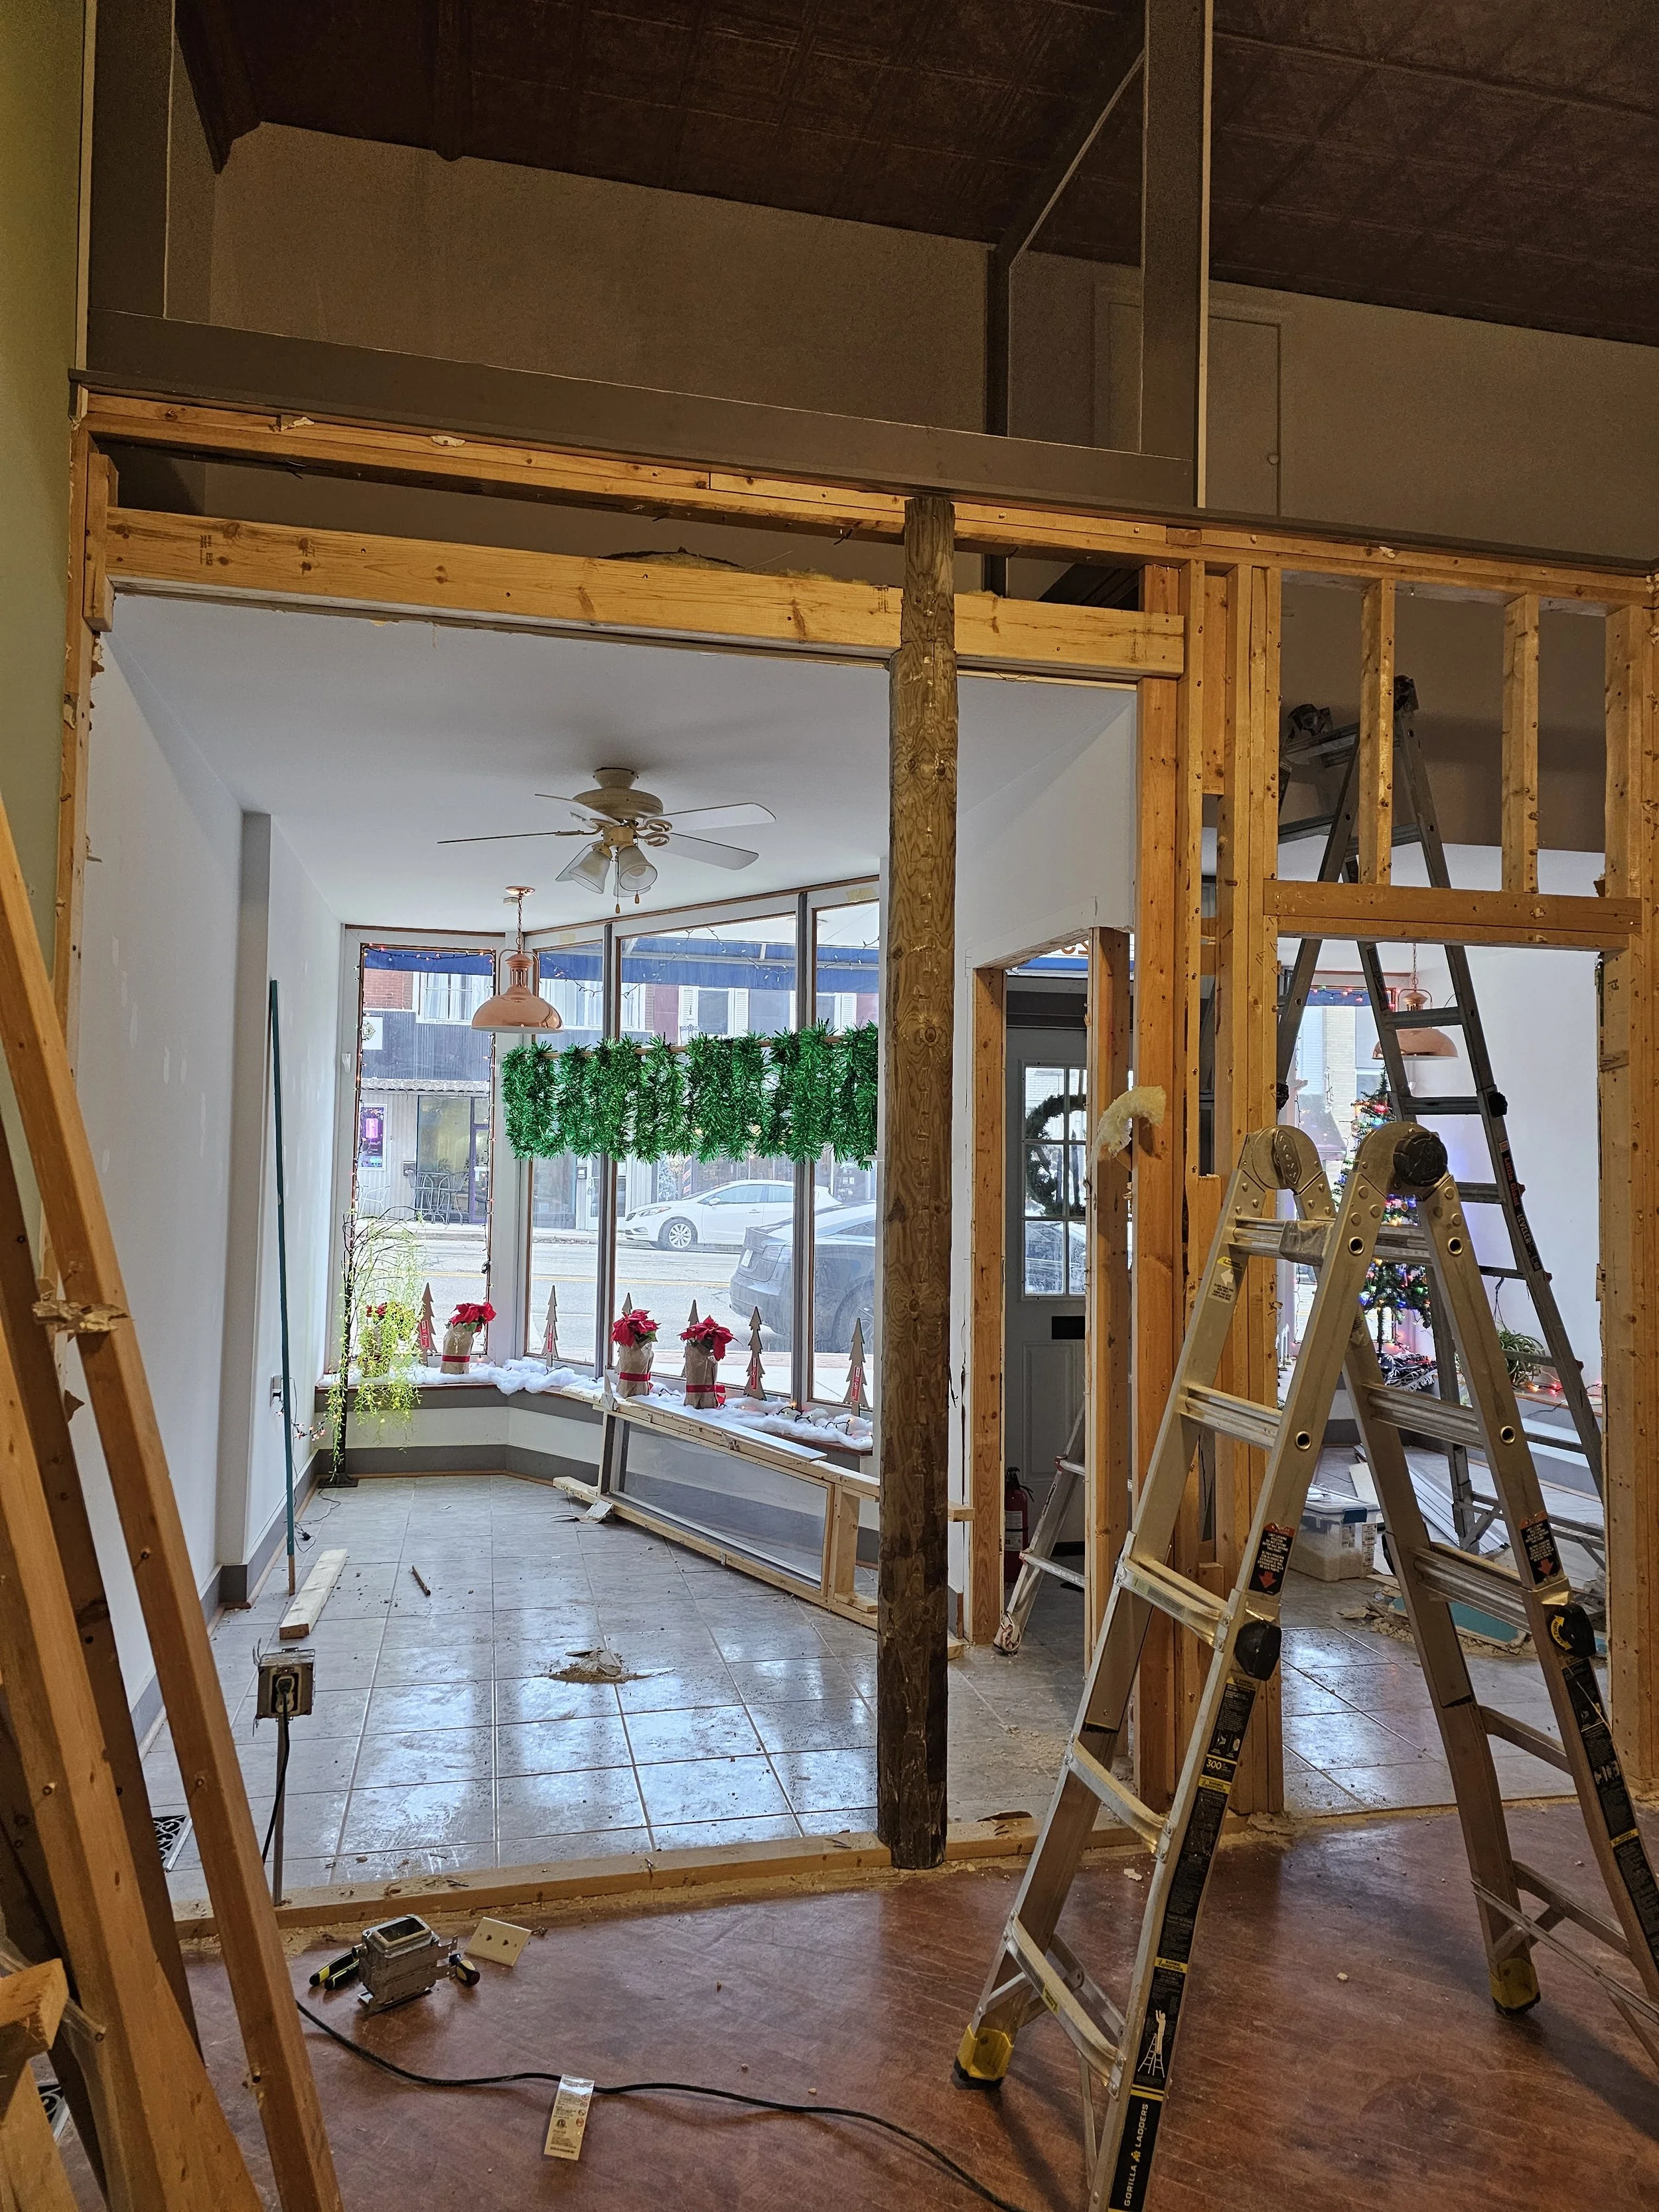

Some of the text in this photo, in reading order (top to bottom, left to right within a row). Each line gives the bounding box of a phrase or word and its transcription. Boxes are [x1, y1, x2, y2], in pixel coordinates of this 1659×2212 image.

[1504, 1157, 1519, 1206] Little Giant
[1517, 1214, 1532, 1244] LEVELER
[1206, 1759, 1222, 1770] 300
[1124, 2103, 1149, 2206] GORILLA LADDERS
